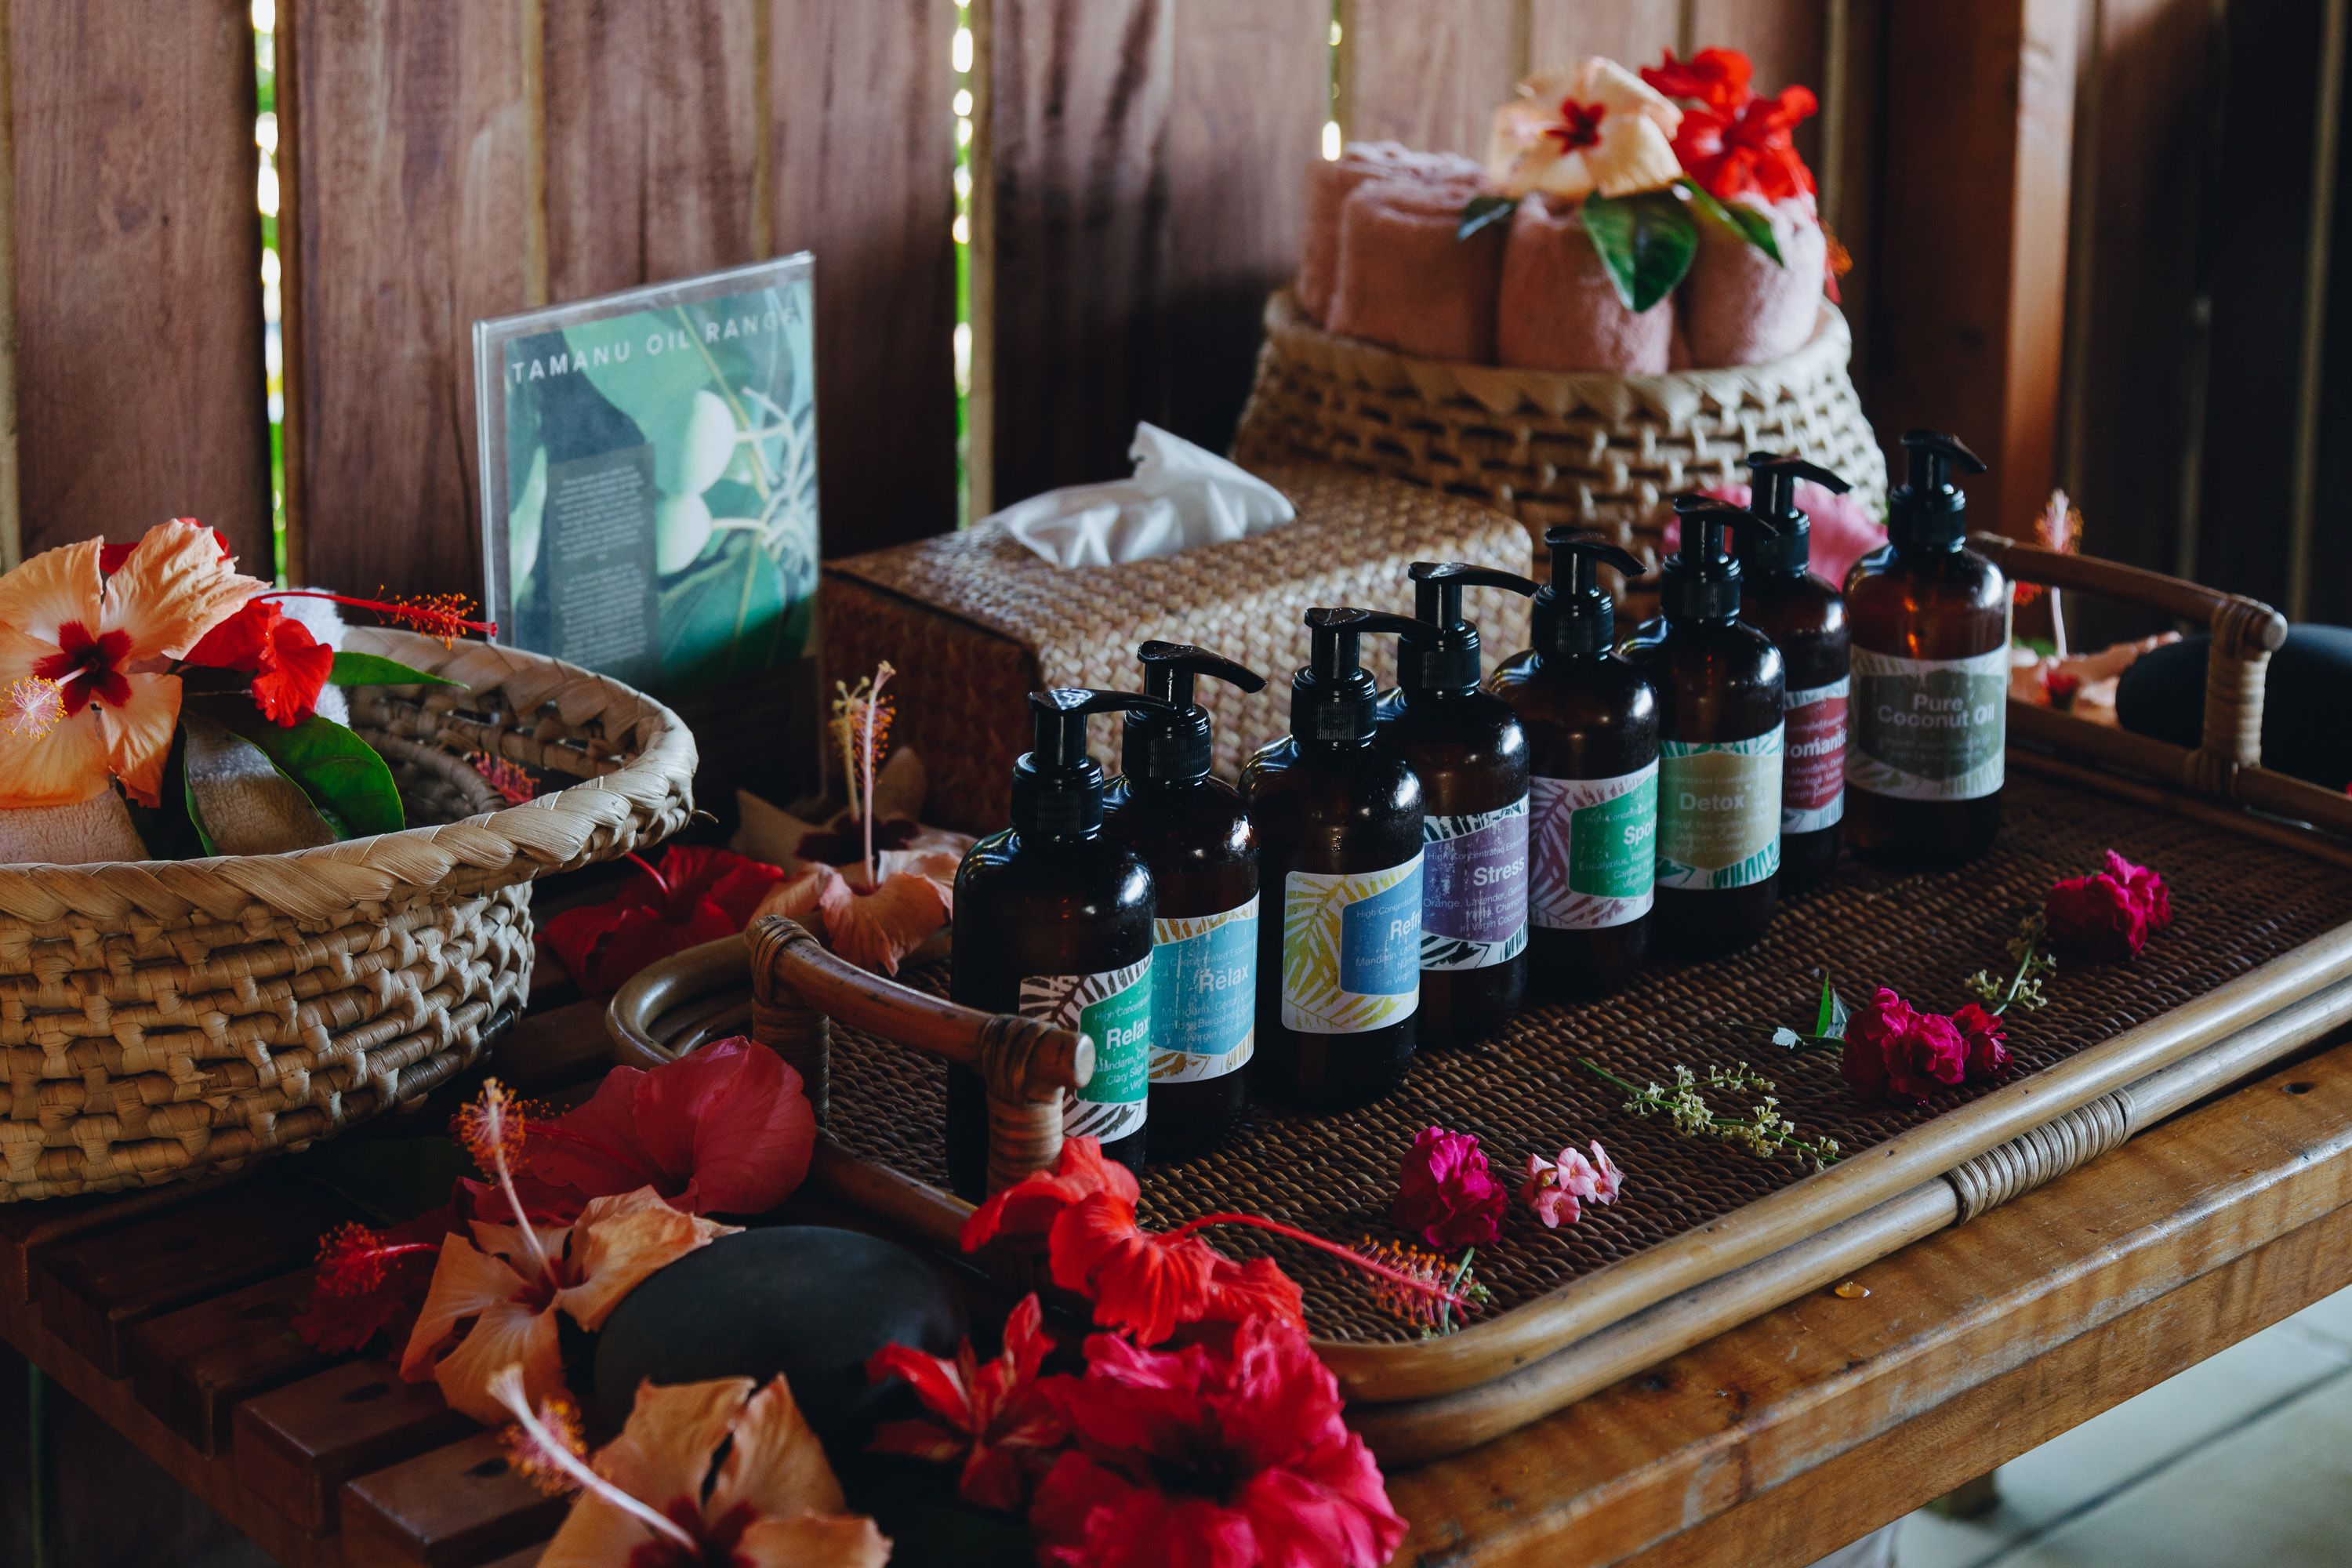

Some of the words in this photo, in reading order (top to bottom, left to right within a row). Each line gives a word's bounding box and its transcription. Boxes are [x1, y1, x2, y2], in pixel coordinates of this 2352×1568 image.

[511, 339, 631, 383] TAMANU
[645, 328, 691, 356] OIL
[705, 306, 795, 345] RANGE
[1878, 704, 1969, 728] Coconut
[1973, 702, 1995, 725] Oil
[1912, 692, 1964, 713] Pure
[1679, 792, 1744, 811] Detox
[1473, 856, 1525, 887] Stress
[1199, 964, 1249, 994] Relax
[1105, 1016, 1150, 1050] Relax
